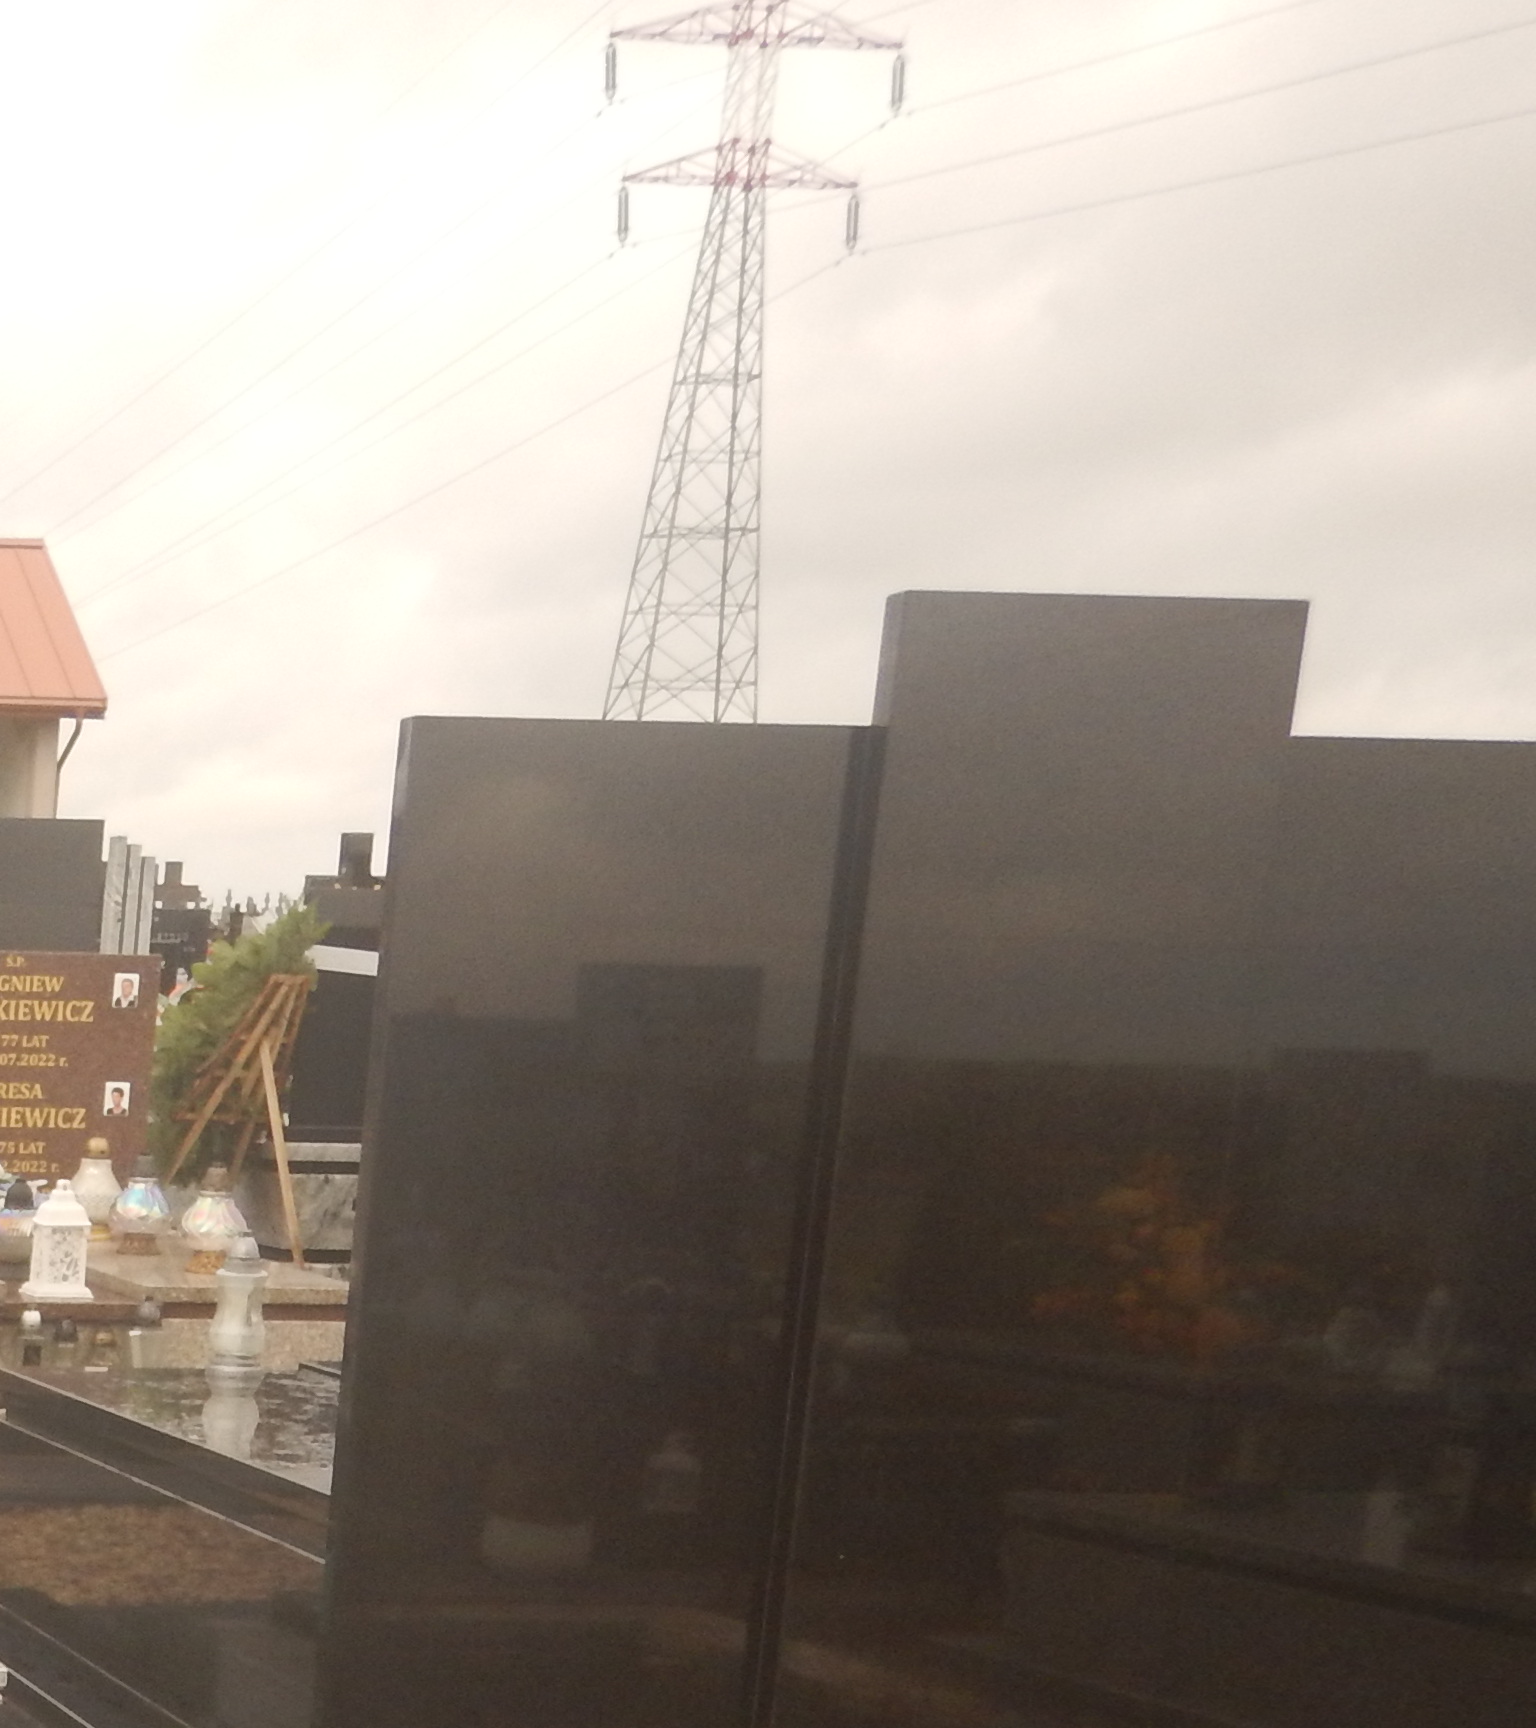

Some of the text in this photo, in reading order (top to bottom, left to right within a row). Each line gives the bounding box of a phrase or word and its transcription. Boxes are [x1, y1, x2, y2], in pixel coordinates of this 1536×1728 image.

[1, 1034, 19, 1047] 77
[22, 1035, 49, 1048] LAT
[59, 1057, 69, 1067] r.
[19, 1142, 46, 1154] LAT
[3, 1161, 47, 1173] 2.2022
